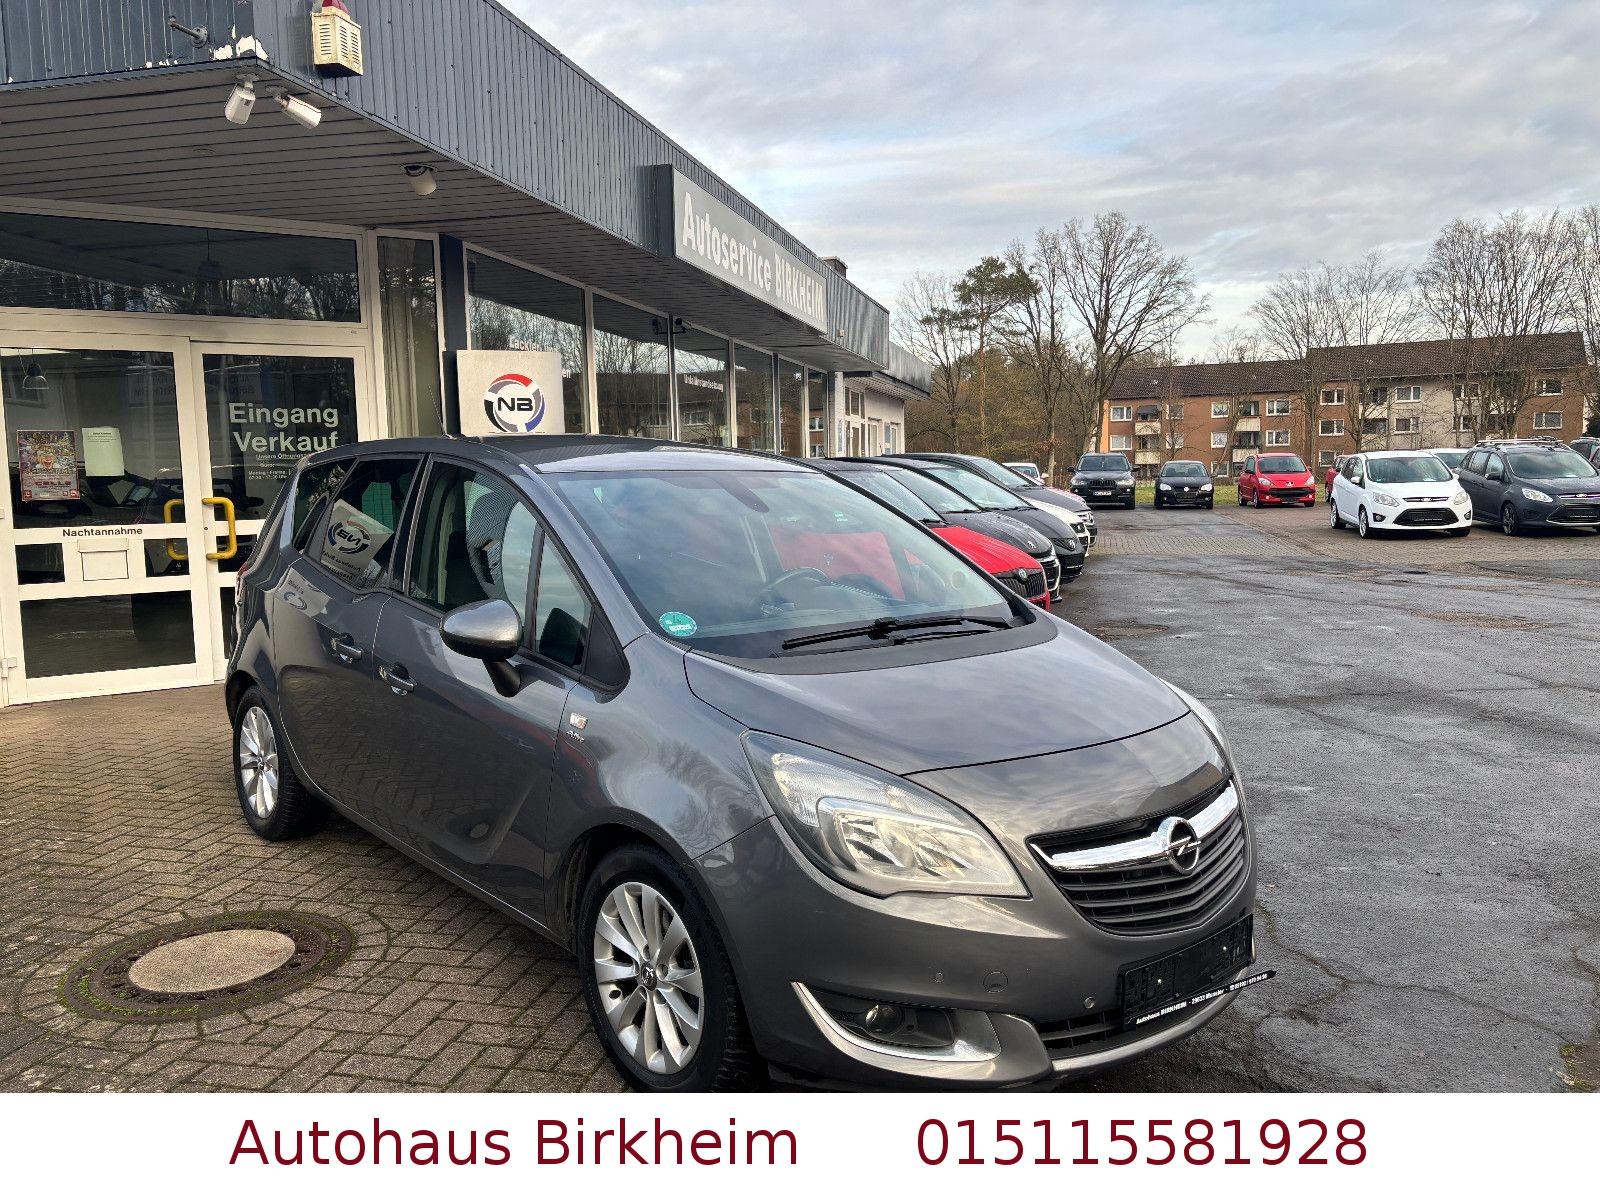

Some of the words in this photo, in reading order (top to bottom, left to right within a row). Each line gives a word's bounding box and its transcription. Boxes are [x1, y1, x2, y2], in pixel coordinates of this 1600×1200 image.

[682, 191, 772, 292] Autoservice
[774, 251, 825, 323] BIRKHEIM
[497, 396, 534, 412] NB
[229, 402, 339, 428] Eingang
[233, 430, 339, 452] Verkauf
[62, 527, 143, 537] Nachtannahme
[1136, 1011, 1160, 1025] Autohaus
